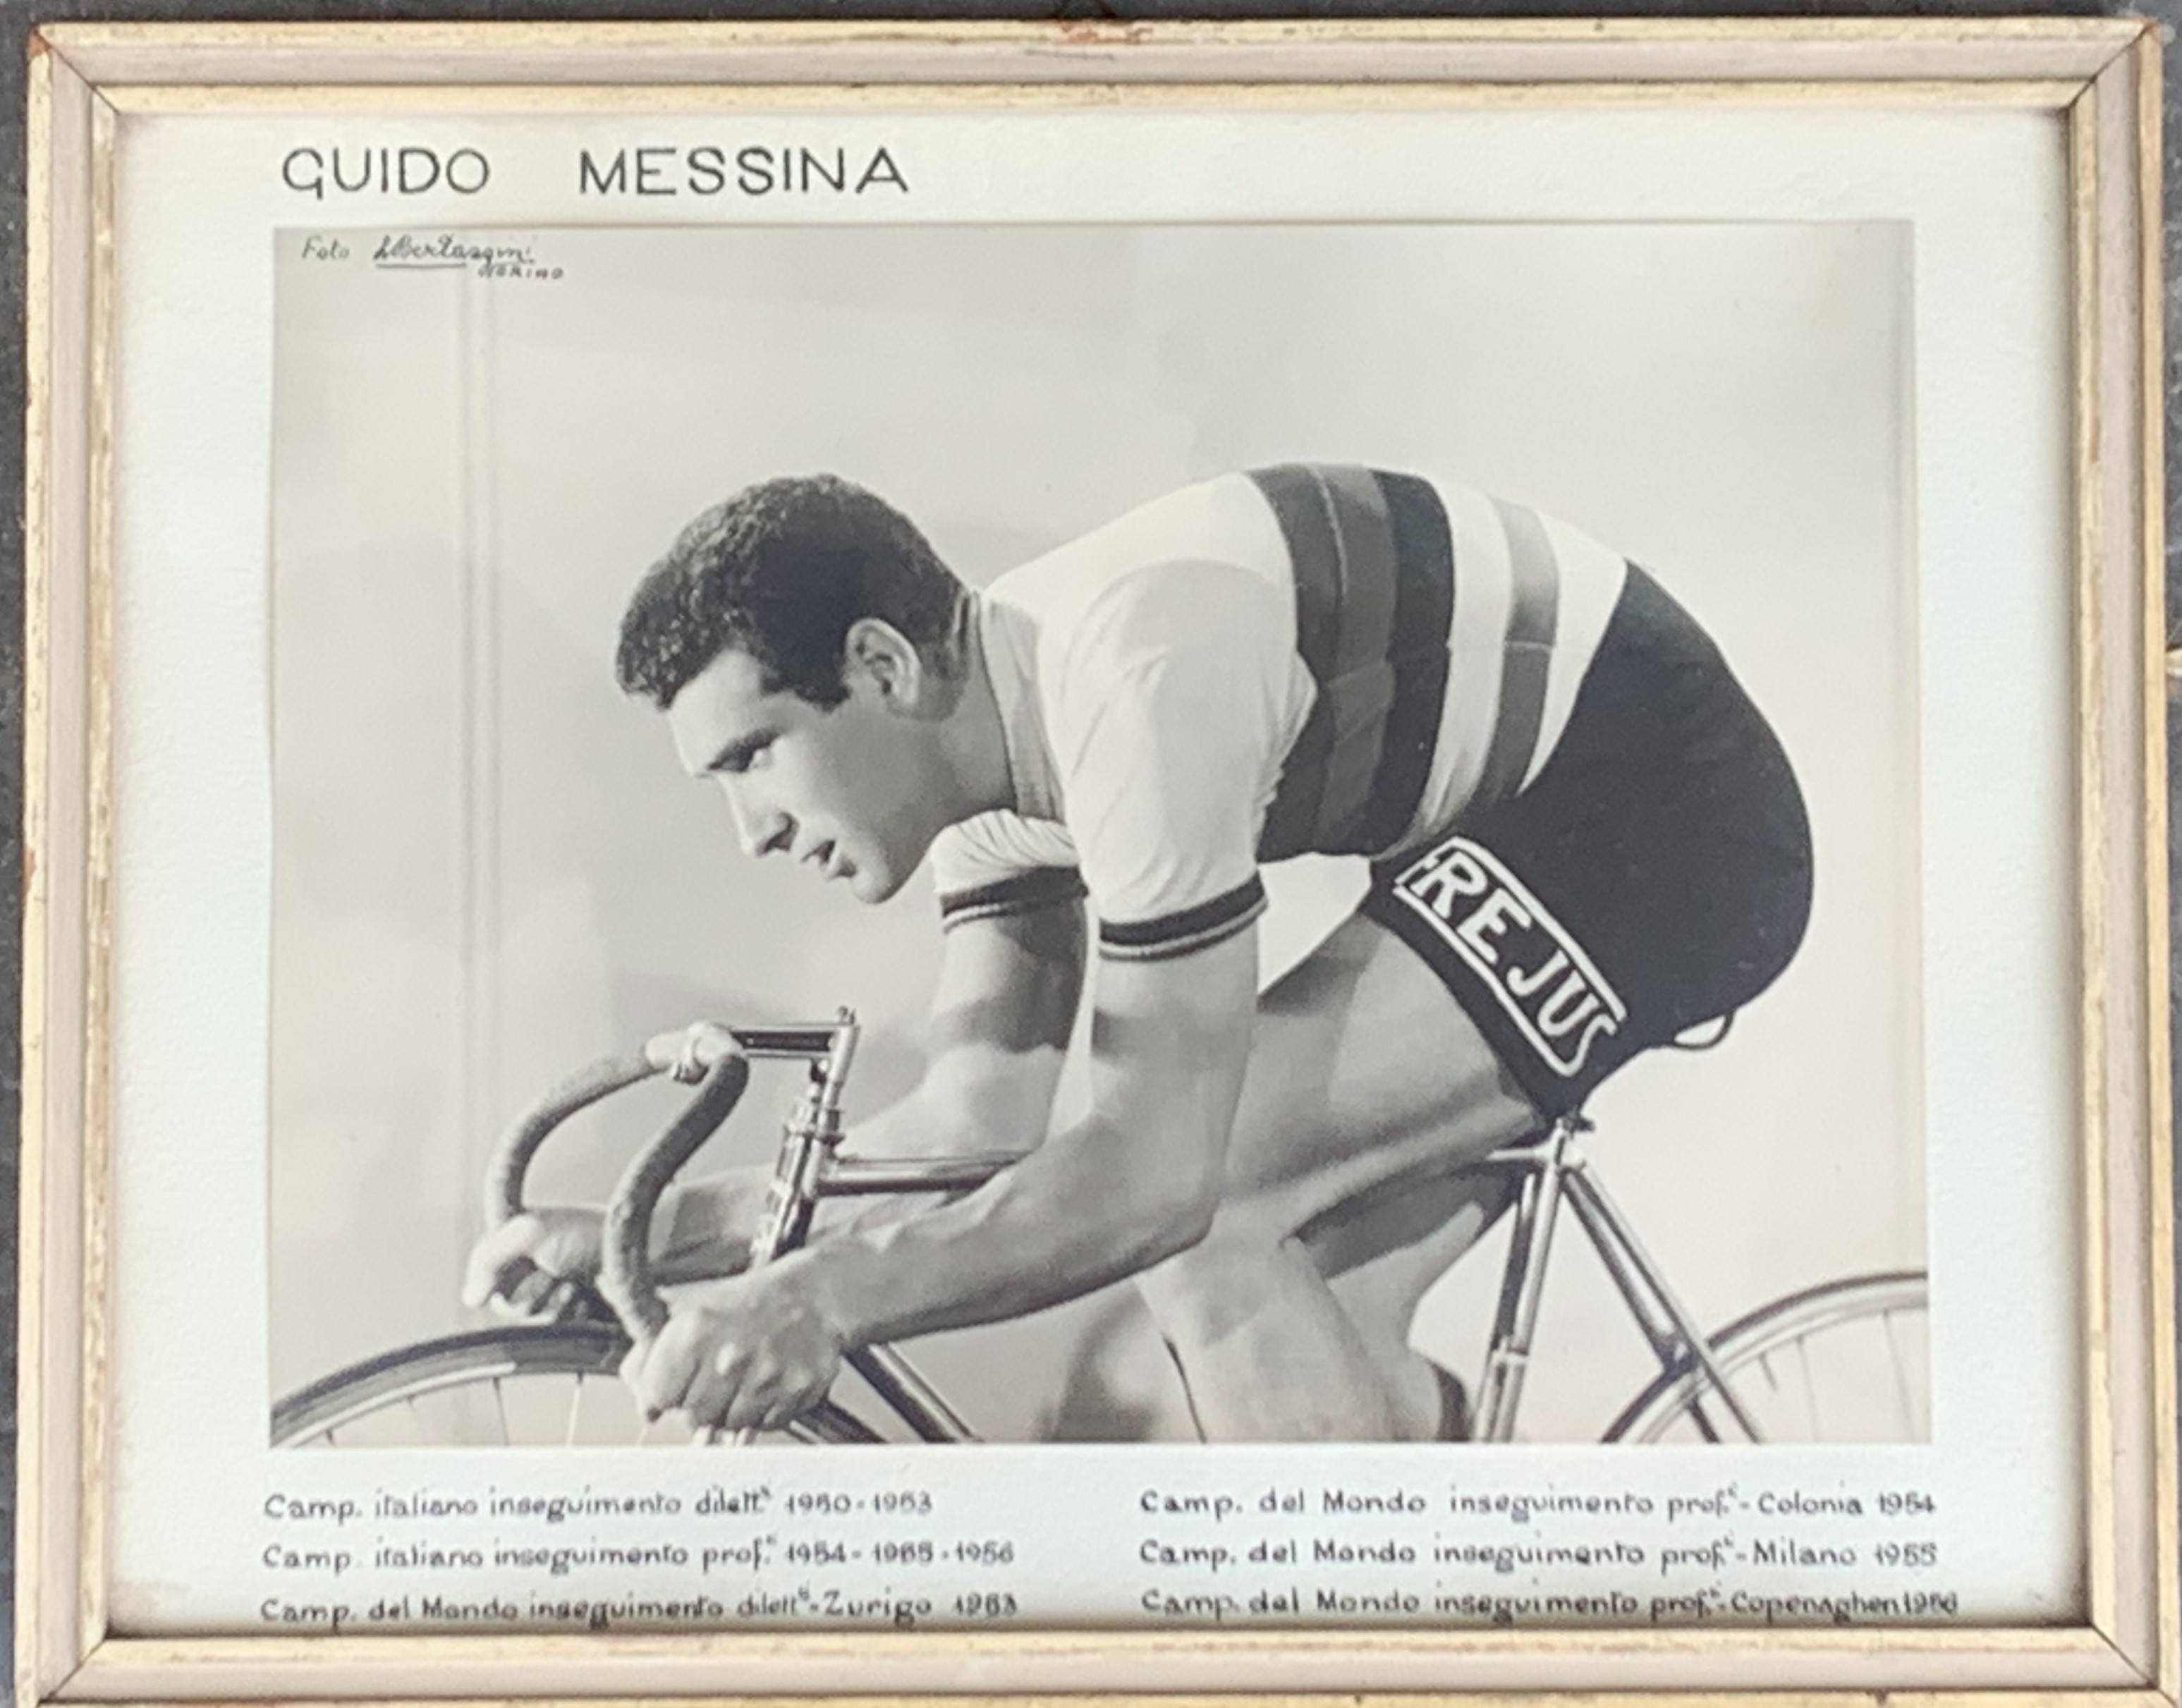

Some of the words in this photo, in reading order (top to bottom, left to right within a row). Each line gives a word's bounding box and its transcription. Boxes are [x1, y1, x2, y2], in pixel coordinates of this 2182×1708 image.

[282, 147, 491, 200] GUIDO
[580, 146, 909, 196] MESSINA
[301, 236, 350, 261] Foto
[264, 1492, 362, 1525] Camp.
[374, 1487, 479, 1517] italiano
[489, 1484, 682, 1524] inseguimento
[1140, 1489, 1244, 1521] Camp.
[1259, 1489, 1305, 1513] del
[1322, 1489, 1427, 1513] Mondo
[1449, 1483, 1654, 1523] inseguimento
[1879, 1493, 1937, 1516] 1954
[262, 1544, 361, 1575] Camp.
[374, 1537, 484, 1568] italiano
[494, 1535, 689, 1575] inseguimento
[1139, 1539, 1237, 1573] Camp.
[1248, 1540, 1298, 1563] del
[1313, 1539, 1416, 1563] Mondo
[1434, 1530, 1645, 1573] inseguimento
[1875, 1541, 1938, 1567] 1955
[260, 1599, 357, 1635] Camp.
[367, 1596, 410, 1621] del
[422, 1597, 519, 1621] Mondo
[530, 1590, 724, 1630] inseguimento
[1141, 1590, 1241, 1622] Camp.
[1248, 1587, 1300, 1614] del
[1316, 1590, 1421, 1613] Mondo
[1434, 1579, 1638, 1623] inseguimento
